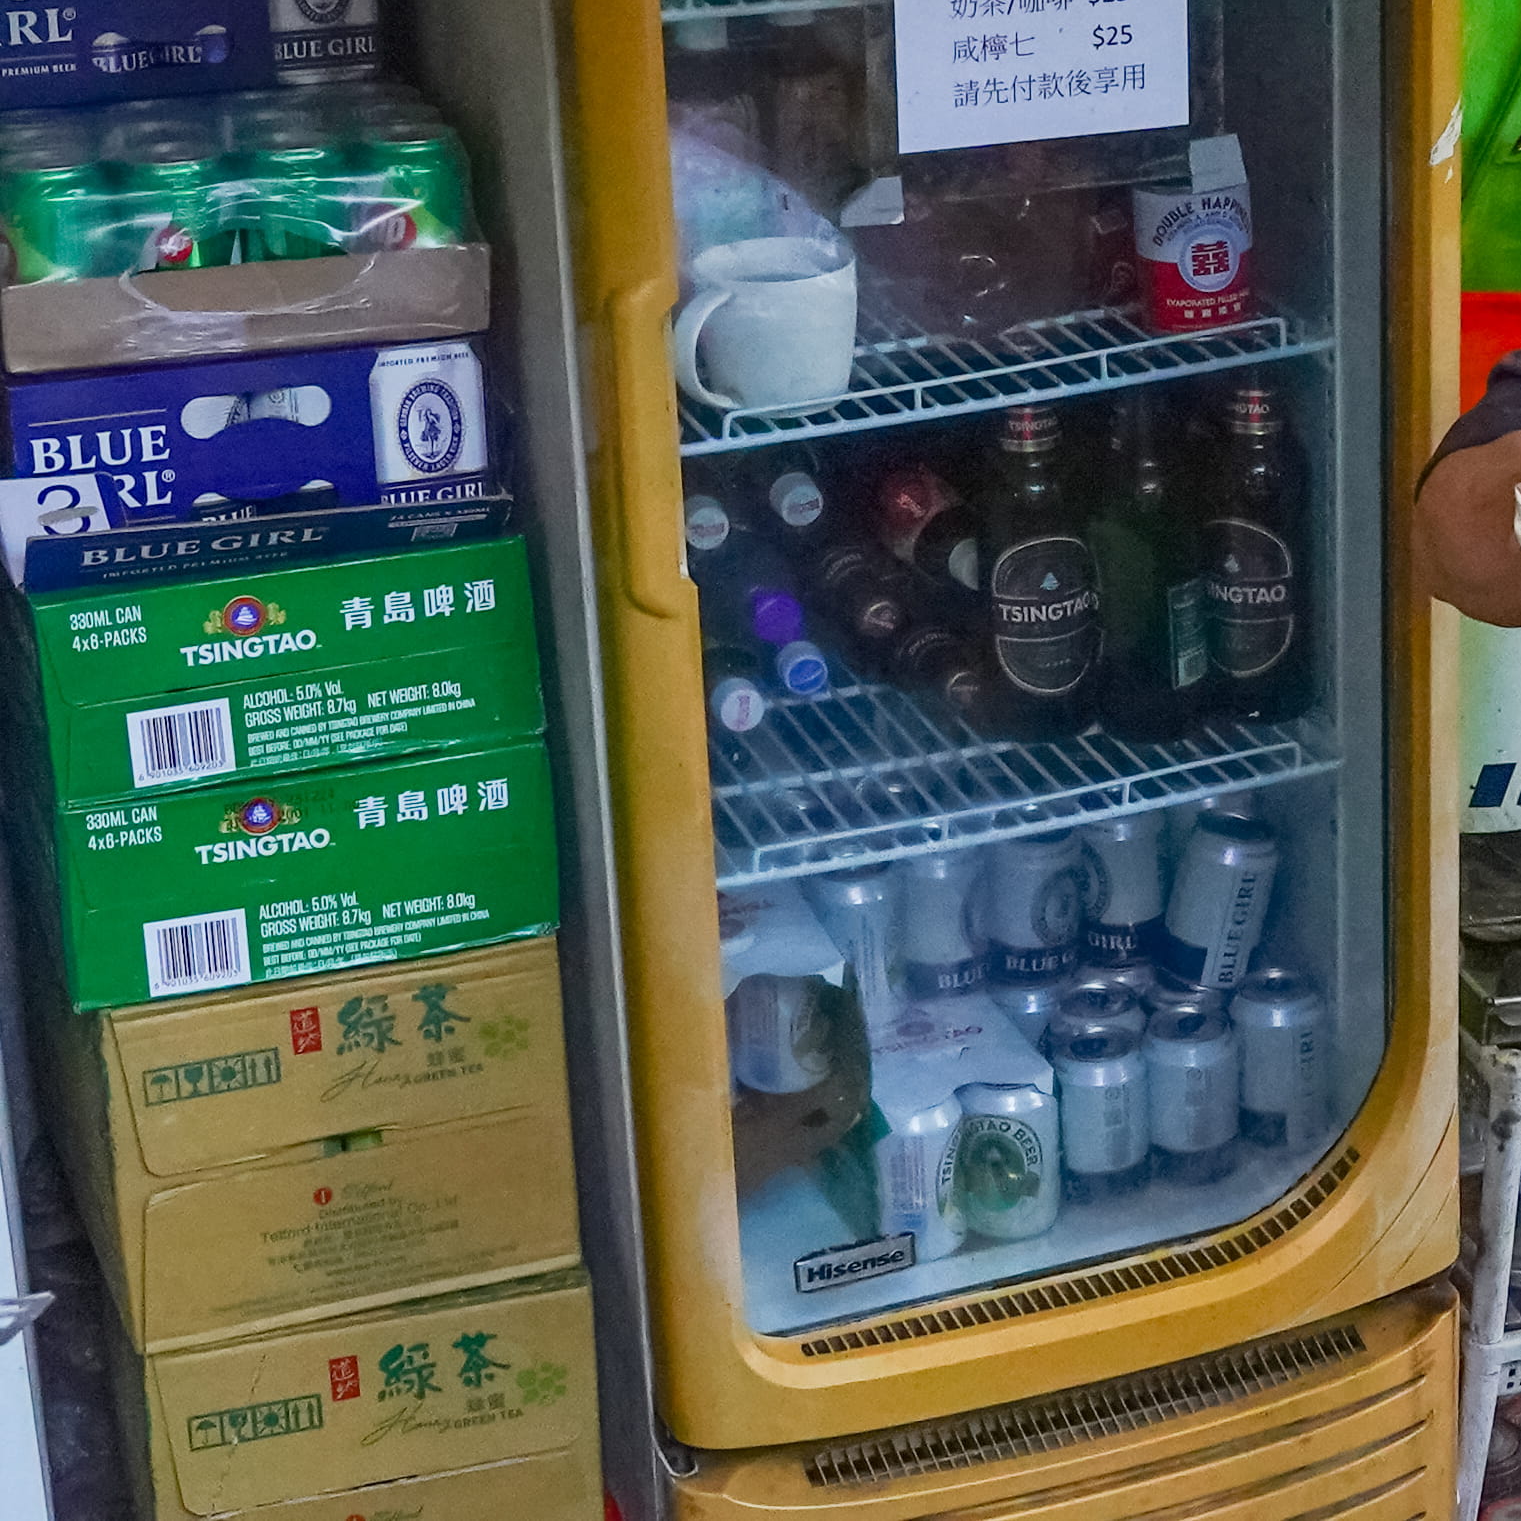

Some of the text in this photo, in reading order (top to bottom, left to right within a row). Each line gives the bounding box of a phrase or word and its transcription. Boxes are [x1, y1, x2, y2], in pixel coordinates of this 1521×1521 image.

[274, 37, 376, 61] BLUE GIRL
[952, 25, 1133, 64] 咸檸七 $25
[954, 63, 1145, 108] 請先付款後享用
[1153, 202, 1194, 246] DOUBLE
[1167, 298, 1216, 307] EVAPORATED
[30, 425, 171, 474] BLUE
[81, 524, 327, 568] BLUE GIRL
[69, 605, 143, 631] 330ML CAN
[339, 578, 496, 632] 青島啤酒
[180, 629, 318, 667] TSINGTAO
[243, 688, 294, 710] ALCOHOL:
[296, 683, 322, 700] 5.0%
[245, 698, 356, 728] GROSS WEIGHT: 8.7kg
[367, 681, 461, 708] NET WEIGHT: 8.0kg
[85, 806, 158, 832] 330ML CAN
[353, 778, 509, 832] 青島啤酒
[195, 829, 331, 866] TSINGTAO
[259, 899, 309, 920] ALCOHOL:
[261, 909, 371, 938] GROSS WEIGHT: 8.7kg
[382, 892, 476, 919] NET WEIGHT: 8.0kg
[1217, 929, 1247, 984] BLUE
[805, 1246, 906, 1284] Hisense
[377, 1331, 511, 1402] 綠茶
[500, 1408, 523, 1420] TEA
